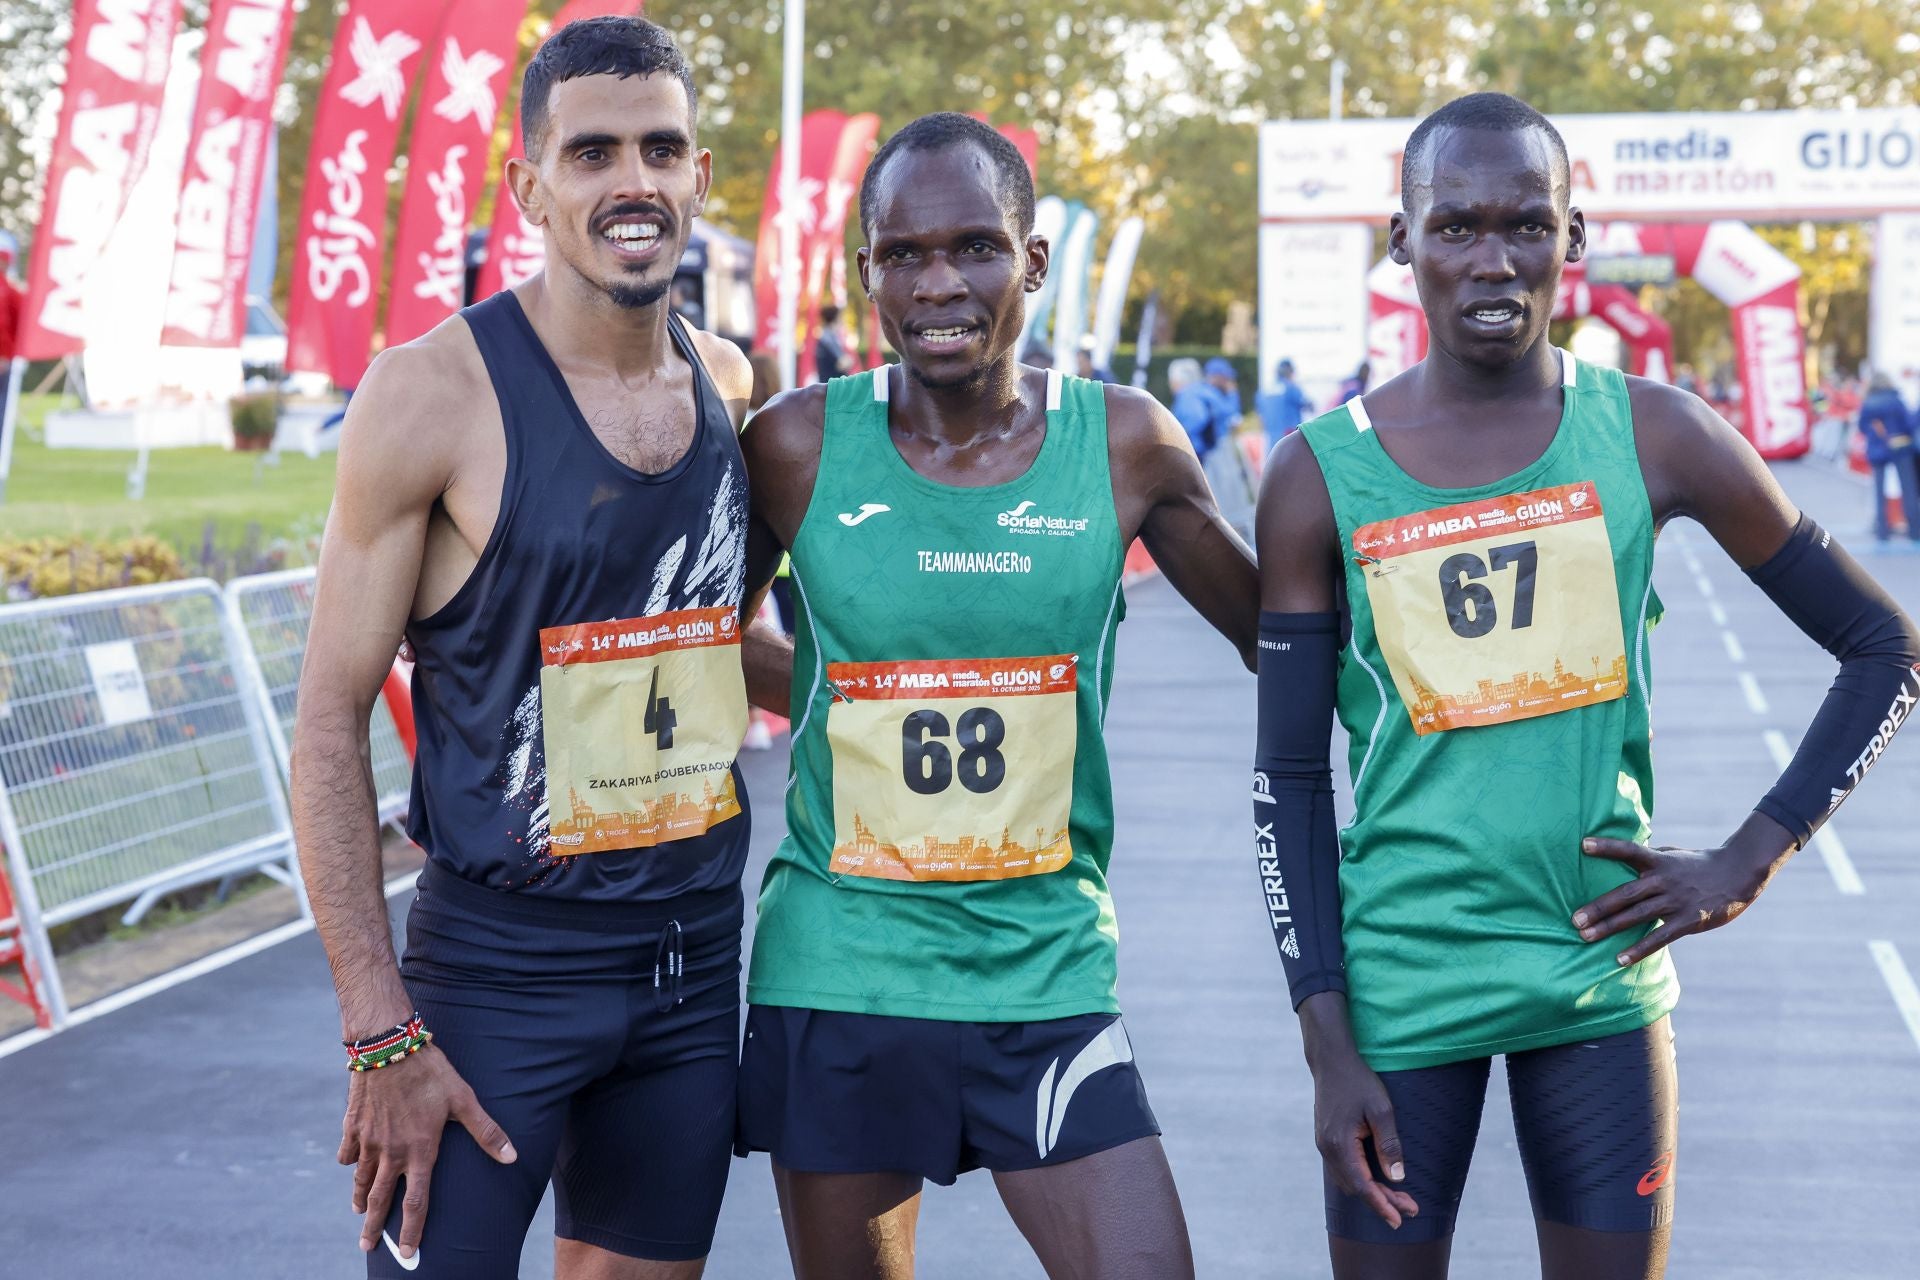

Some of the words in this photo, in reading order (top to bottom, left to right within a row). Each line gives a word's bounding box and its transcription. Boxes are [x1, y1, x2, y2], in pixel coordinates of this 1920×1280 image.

[1614, 129, 1731, 161] media
[1614, 166, 1775, 194] maratón
[1801, 122, 1920, 170] GIJÓ
[1427, 515, 1477, 538] MBA
[1478, 508, 1505, 520] media
[1516, 499, 1563, 520] GIJÓN
[1480, 515, 1516, 528] maratón
[917, 551, 1032, 573] TEAMMANAGER10
[1438, 540, 1538, 638] 67
[618, 631, 657, 649] MBA
[677, 619, 713, 639] GIJÓN
[899, 672, 949, 688] MBA
[952, 670, 980, 680] media
[991, 668, 1040, 686] GIJÓN
[953, 678, 990, 687] maratón
[644, 665, 677, 750] 4
[1846, 682, 1917, 785] TERREX
[902, 707, 1006, 795] 68
[589, 777, 652, 789] ZAKARIYA
[1254, 822, 1292, 930] TERREX
[1288, 927, 1300, 959] adidas
